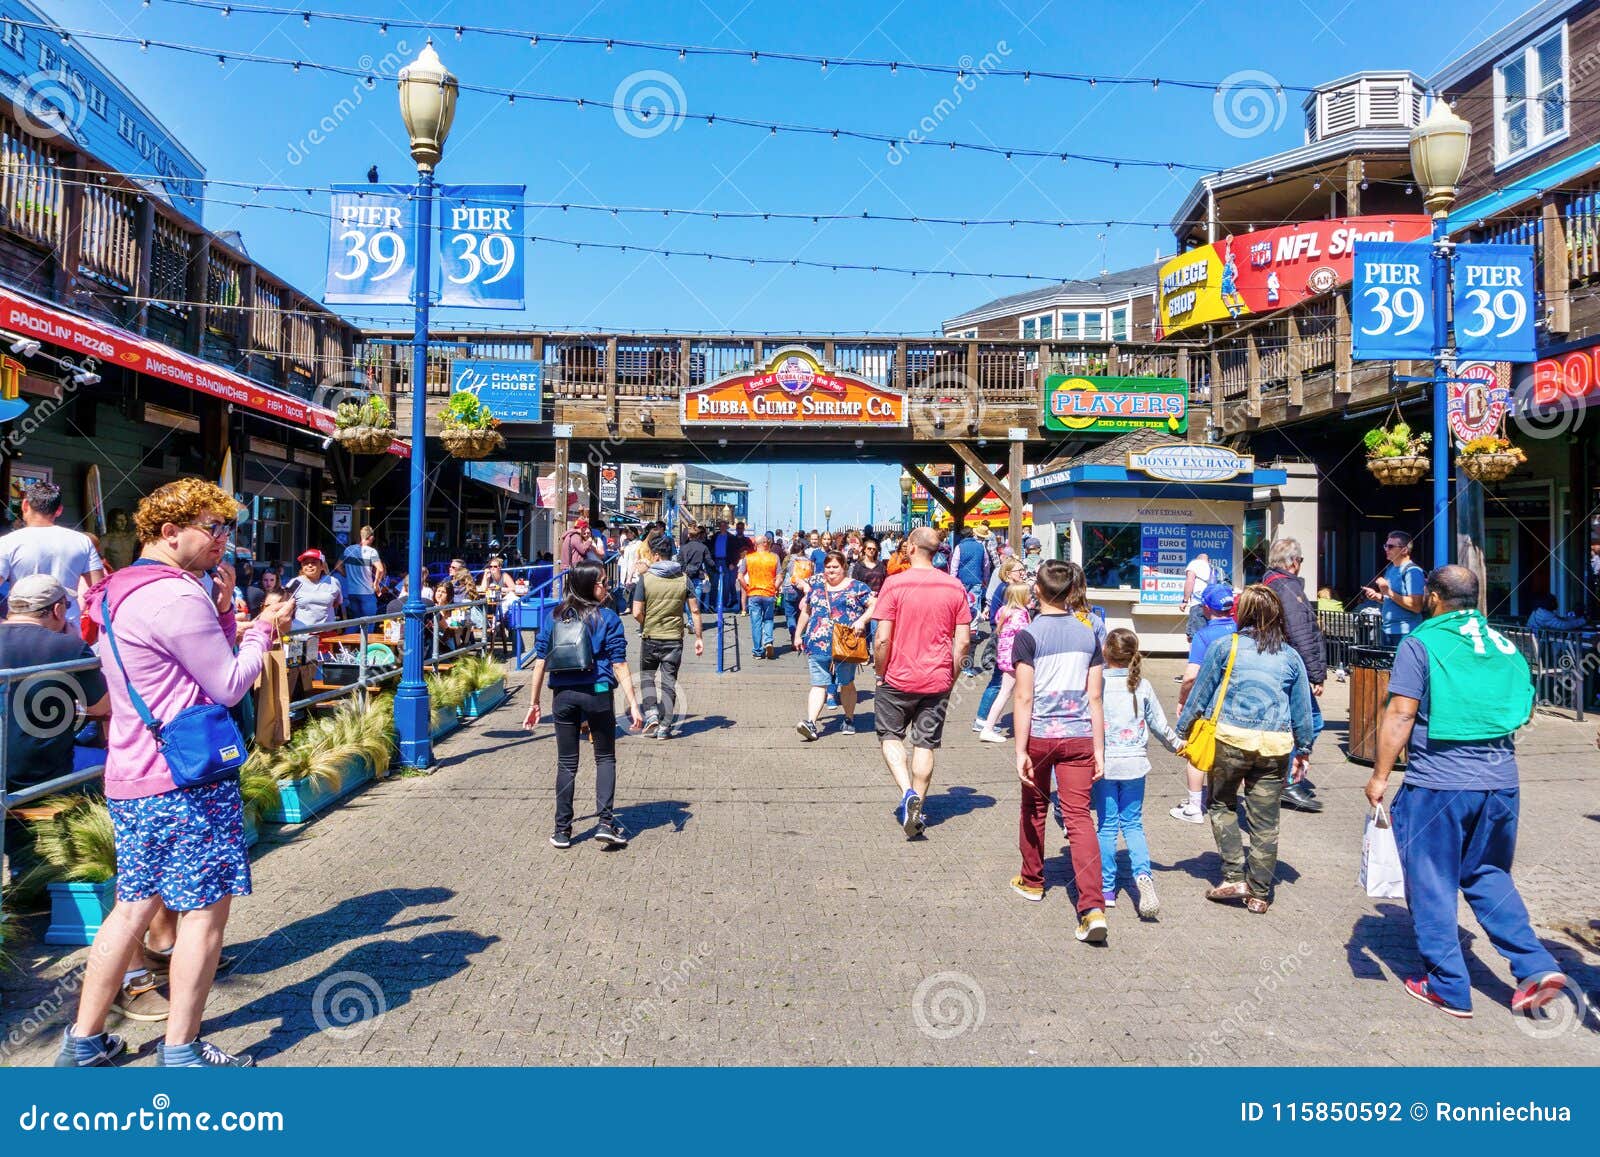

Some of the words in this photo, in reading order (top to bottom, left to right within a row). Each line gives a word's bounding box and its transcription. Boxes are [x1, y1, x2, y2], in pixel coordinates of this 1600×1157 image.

[38, 39, 109, 123] FISH
[117, 107, 194, 201] HOUSE
[341, 206, 403, 229] PIER
[451, 207, 512, 230] PIER
[334, 230, 406, 281] 39
[448, 232, 515, 285] 39
[1275, 235, 1322, 262] NFL
[1162, 259, 1208, 295] COLLEGE
[1364, 262, 1422, 285] PIER
[1465, 265, 1524, 287] PIER
[1168, 291, 1197, 318] SHOP
[1361, 286, 1425, 336] 39
[1463, 289, 1527, 338] 39
[10, 309, 71, 340] PADDLIN'
[73, 331, 115, 357] PIZZAS
[145, 357, 193, 383] AWESOME
[196, 371, 248, 402] SANDWICHES
[491, 373, 537, 382] CHART
[491, 382, 537, 391] HOUSE
[750, 379, 764, 389] End
[765, 375, 773, 384] of
[816, 376, 828, 386] the
[829, 380, 844, 391] Pier
[1533, 345, 1600, 405] BO
[267, 399, 283, 412] FISH
[285, 404, 304, 419] TACOS
[696, 393, 749, 415] BUBBA
[753, 395, 797, 415] GUMP
[802, 396, 862, 416] SHRIMP
[1054, 393, 1182, 415] PLAYERS
[1129, 420, 1145, 428] THE
[1137, 456, 1179, 467] MONEY
[1183, 457, 1246, 469] EXCHANGE
[1143, 526, 1187, 536] CHANGE
[1190, 530, 1230, 539] CHANGE
[1180, 540, 1186, 548] €
[1193, 540, 1227, 549] MONEY
[1142, 593, 1158, 601] Ask
[1160, 593, 1184, 601] Insid
